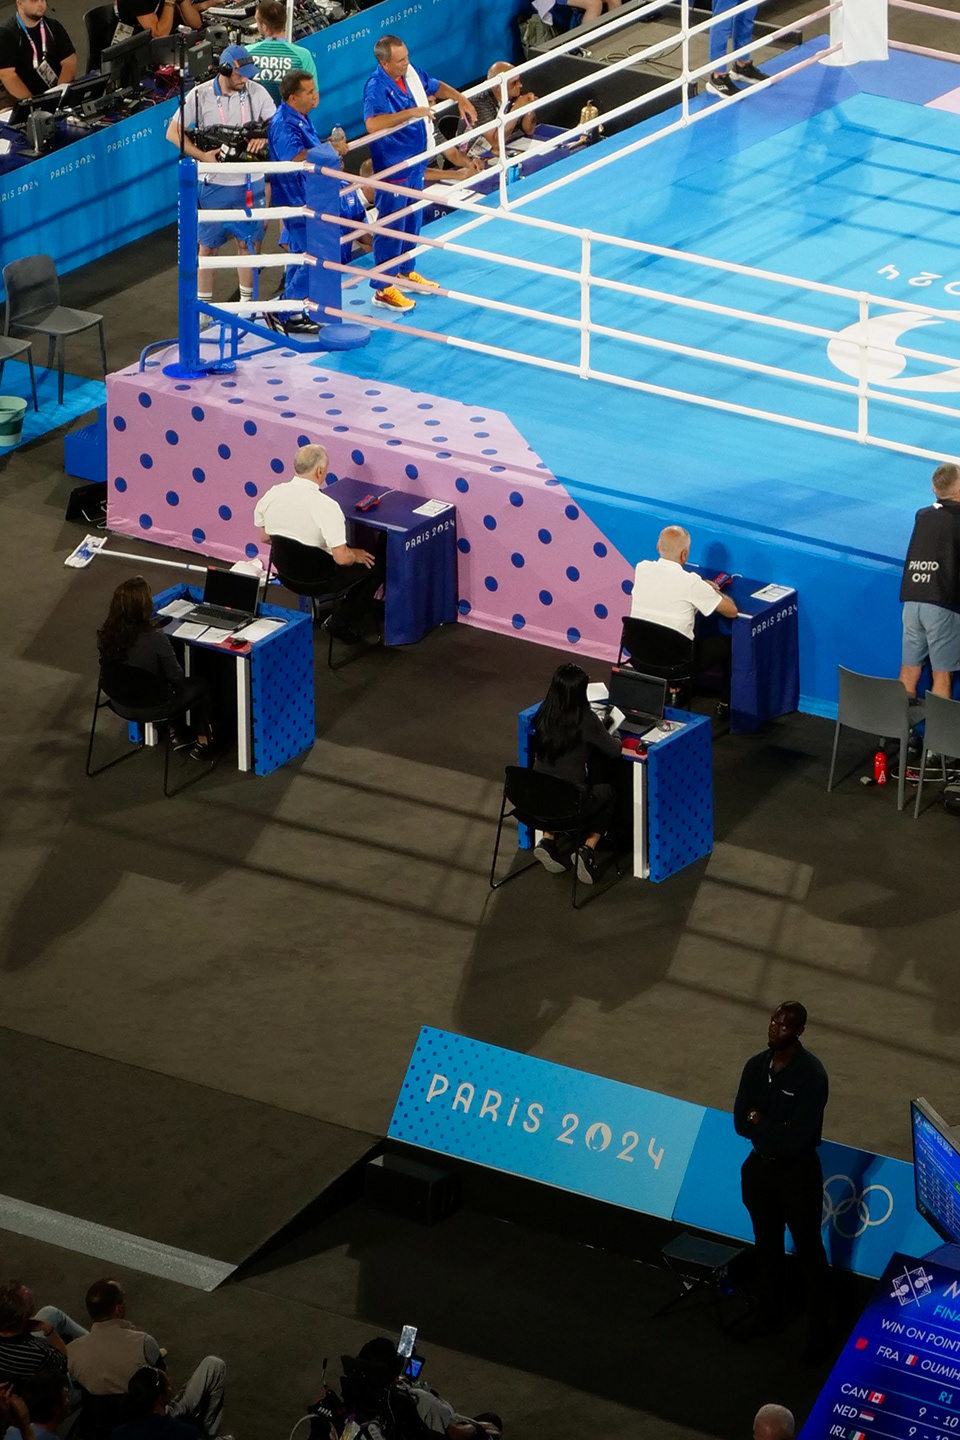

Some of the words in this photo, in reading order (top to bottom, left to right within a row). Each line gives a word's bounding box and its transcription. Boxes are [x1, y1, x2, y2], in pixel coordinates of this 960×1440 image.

[403, 3, 423, 18] 2024
[351, 27, 371, 43] 2024
[131, 127, 153, 142] 2024
[75, 153, 96, 169] 2024
[17, 180, 39, 196] 2024
[431, 519, 455, 537] 2024
[908, 560, 940, 572] PHOTO
[912, 572, 931, 583] 091
[776, 604, 797, 622] 2024
[556, 1113, 665, 1170] 2024
[881, 1318, 902, 1335] WIN
[906, 1327, 926, 1341] ON
[876, 1345, 899, 1362] FRA
[840, 1383, 868, 1400] CAN
[918, 1407, 927, 1417] 9
[942, 1415, 959, 1428] 10
[938, 1390, 953, 1405] R1
[832, 1403, 858, 1419] NED
[908, 1426, 917, 1437] 9
[829, 1424, 847, 1439] IRL
